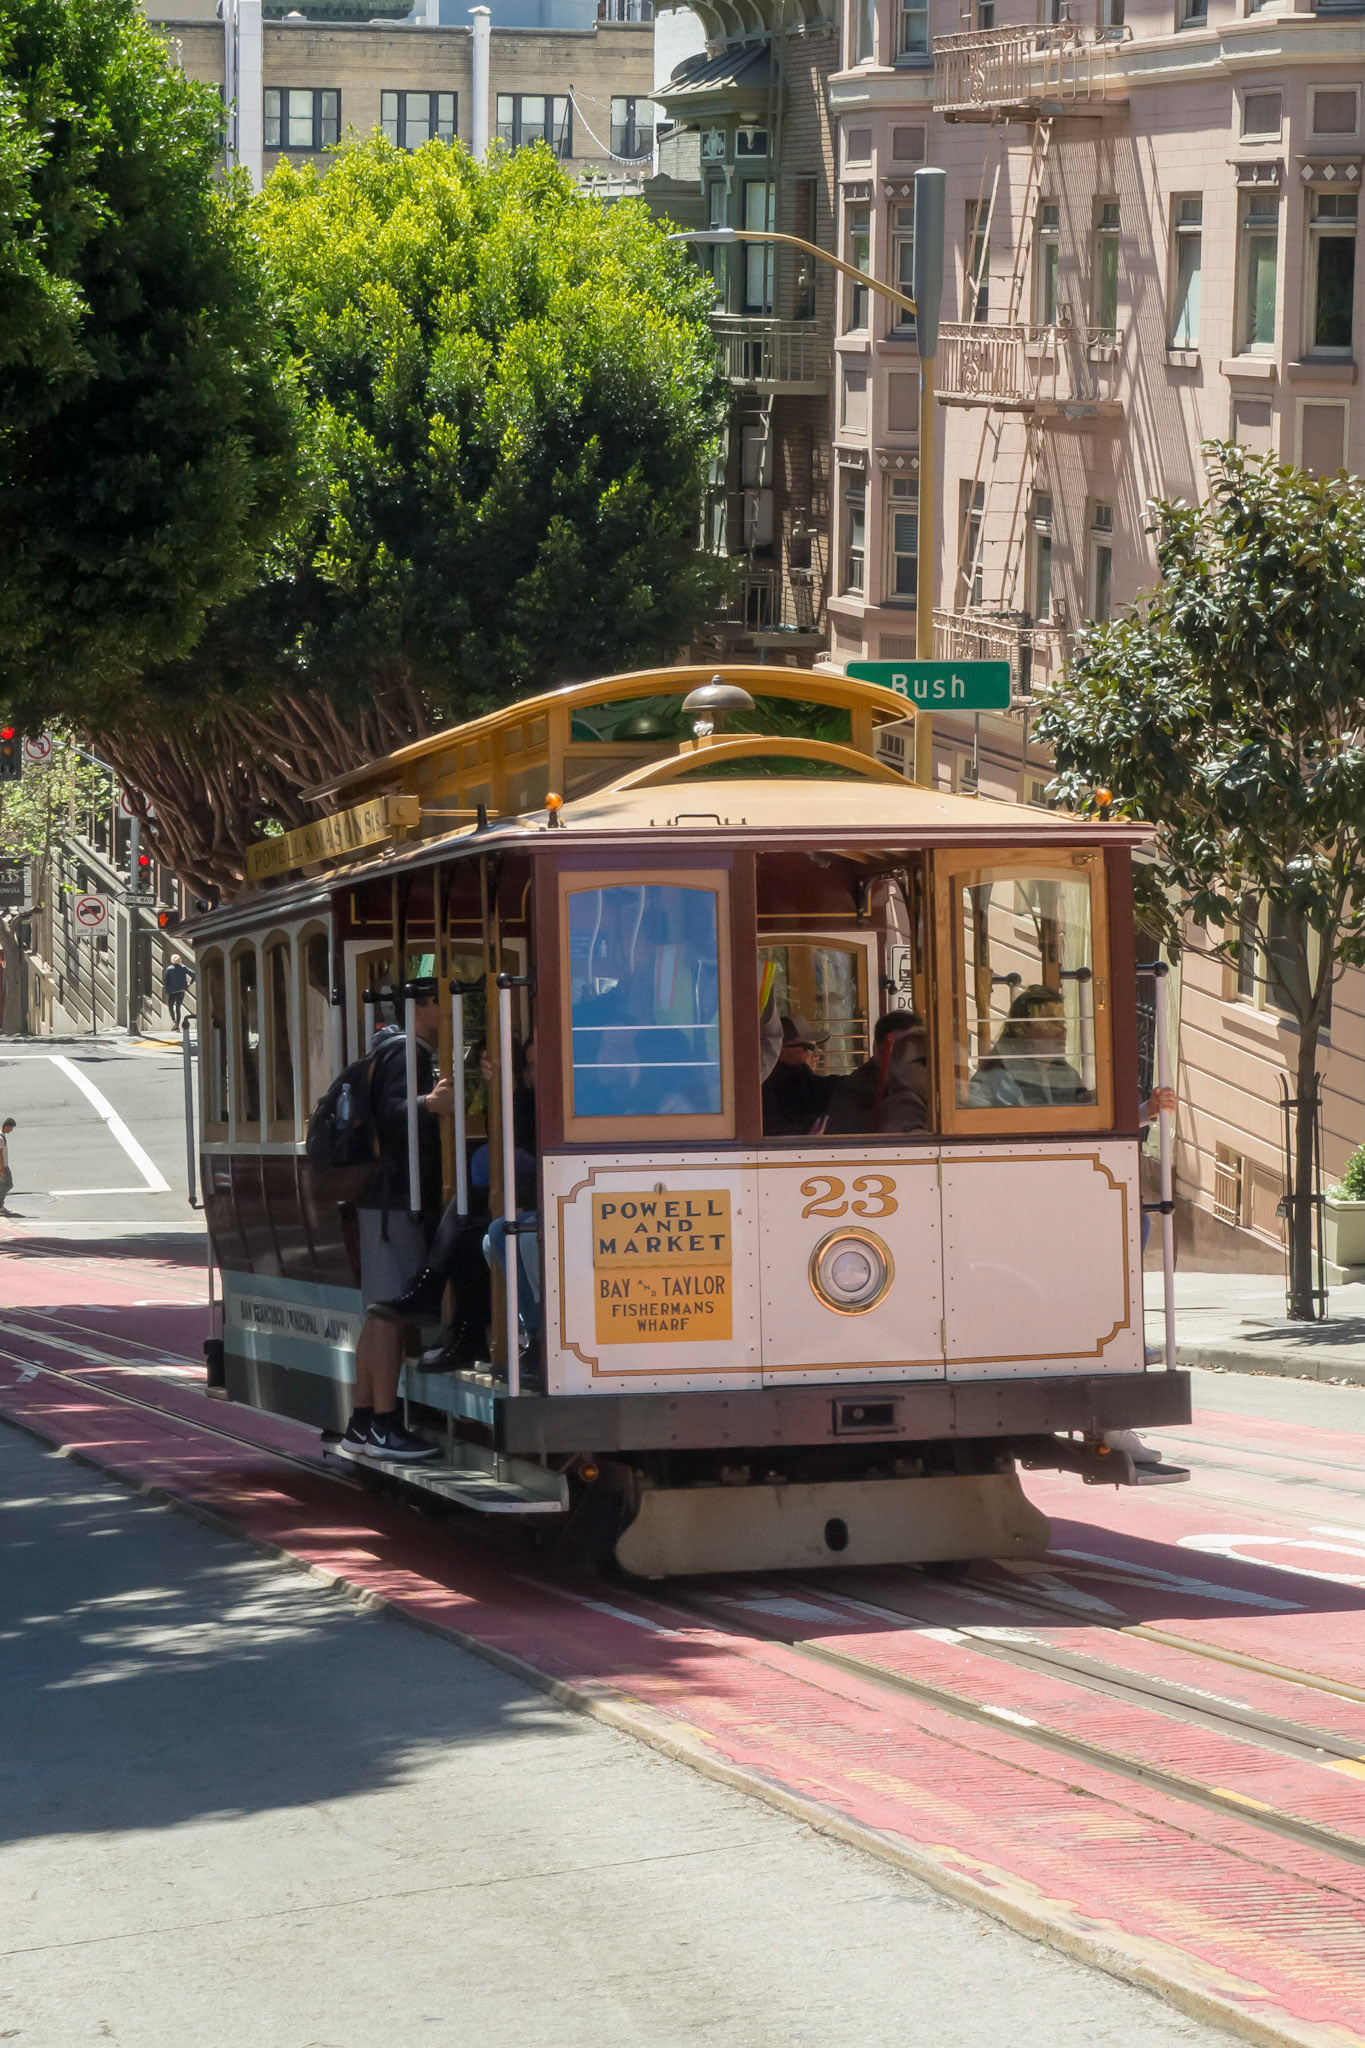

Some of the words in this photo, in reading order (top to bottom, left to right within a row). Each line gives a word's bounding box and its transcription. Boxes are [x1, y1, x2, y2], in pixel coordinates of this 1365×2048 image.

[891, 673, 965, 698] Bush
[254, 838, 304, 872] POWELL
[314, 816, 363, 851] MASON
[800, 1174, 899, 1219] 23
[601, 1200, 723, 1220] POWELL
[634, 1219, 693, 1233] AND
[599, 1234, 726, 1255] MARKET
[600, 1278, 631, 1298] BAY
[638, 1280, 657, 1297] AND
[662, 1275, 725, 1296] TAYLOR
[612, 1301, 714, 1317] FISHERMANS
[637, 1317, 690, 1332] WHARF
